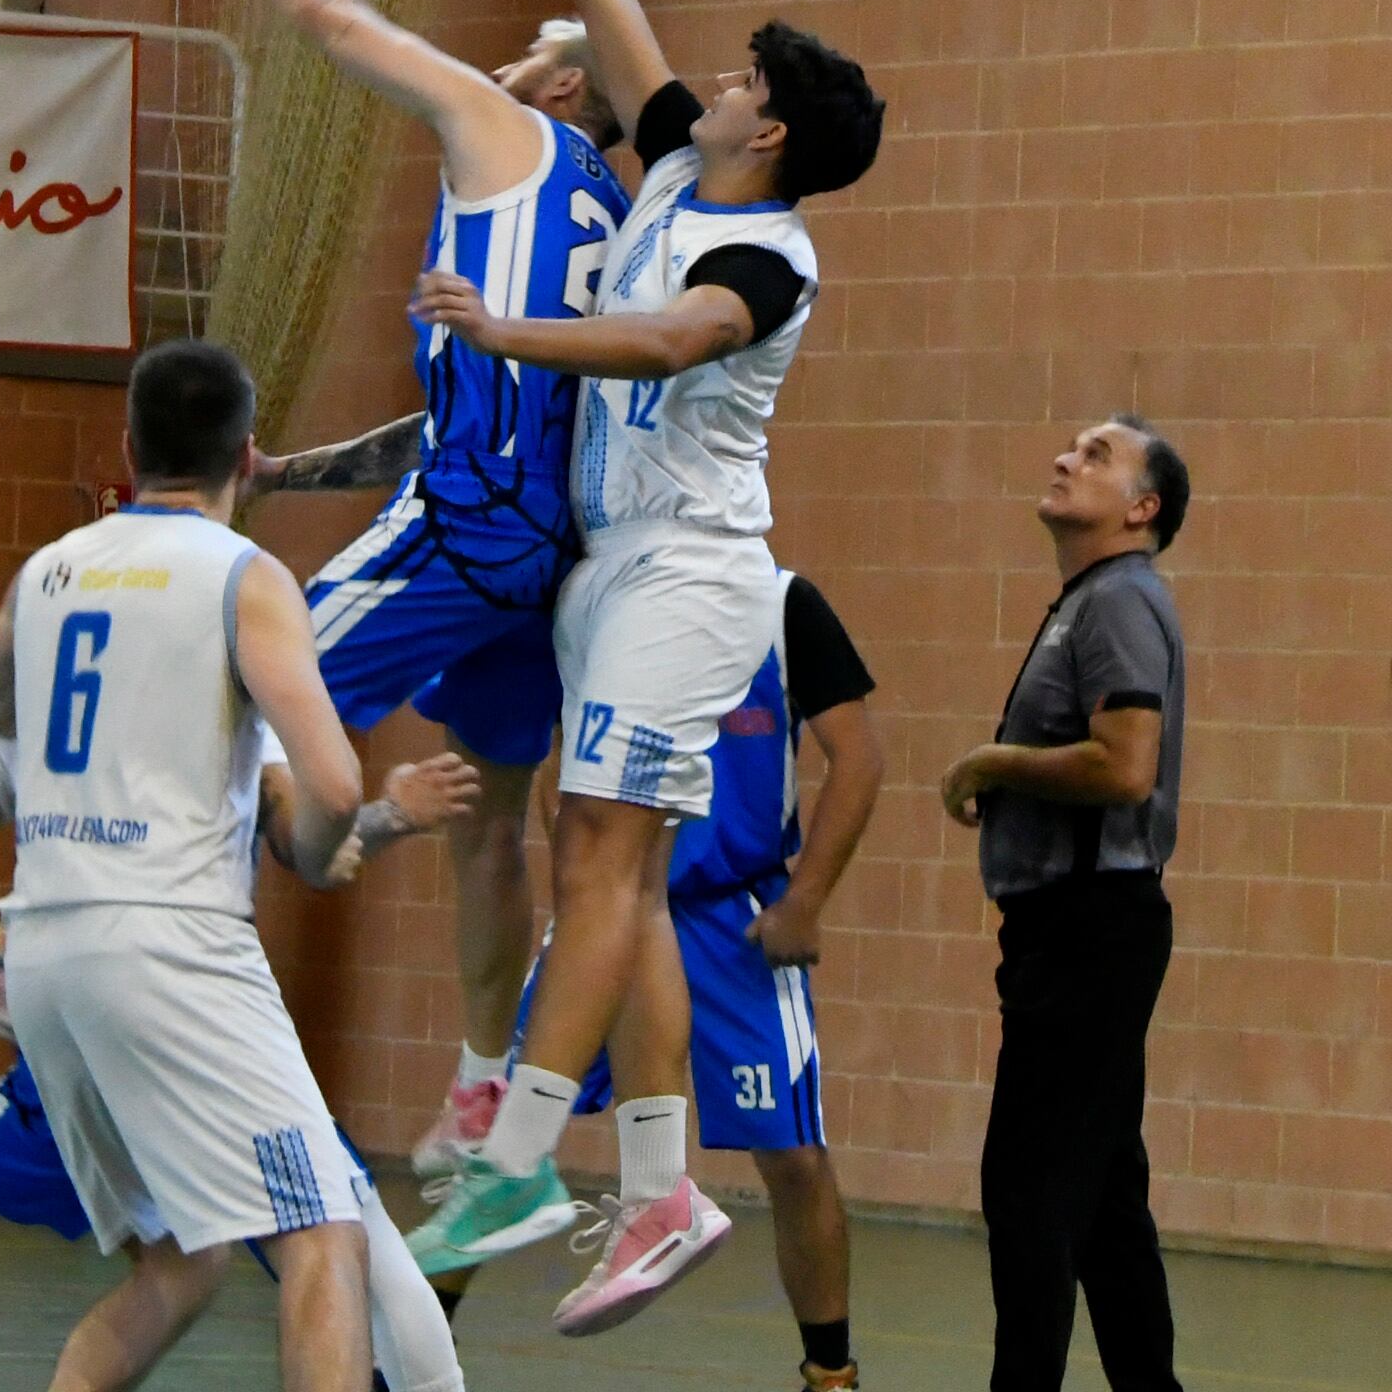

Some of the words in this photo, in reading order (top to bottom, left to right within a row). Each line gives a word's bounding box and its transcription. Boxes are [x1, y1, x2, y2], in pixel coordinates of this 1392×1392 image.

[624, 378, 663, 432] 12
[44, 610, 113, 775] 6
[575, 701, 615, 764] 12
[732, 1063, 776, 1110] 31
